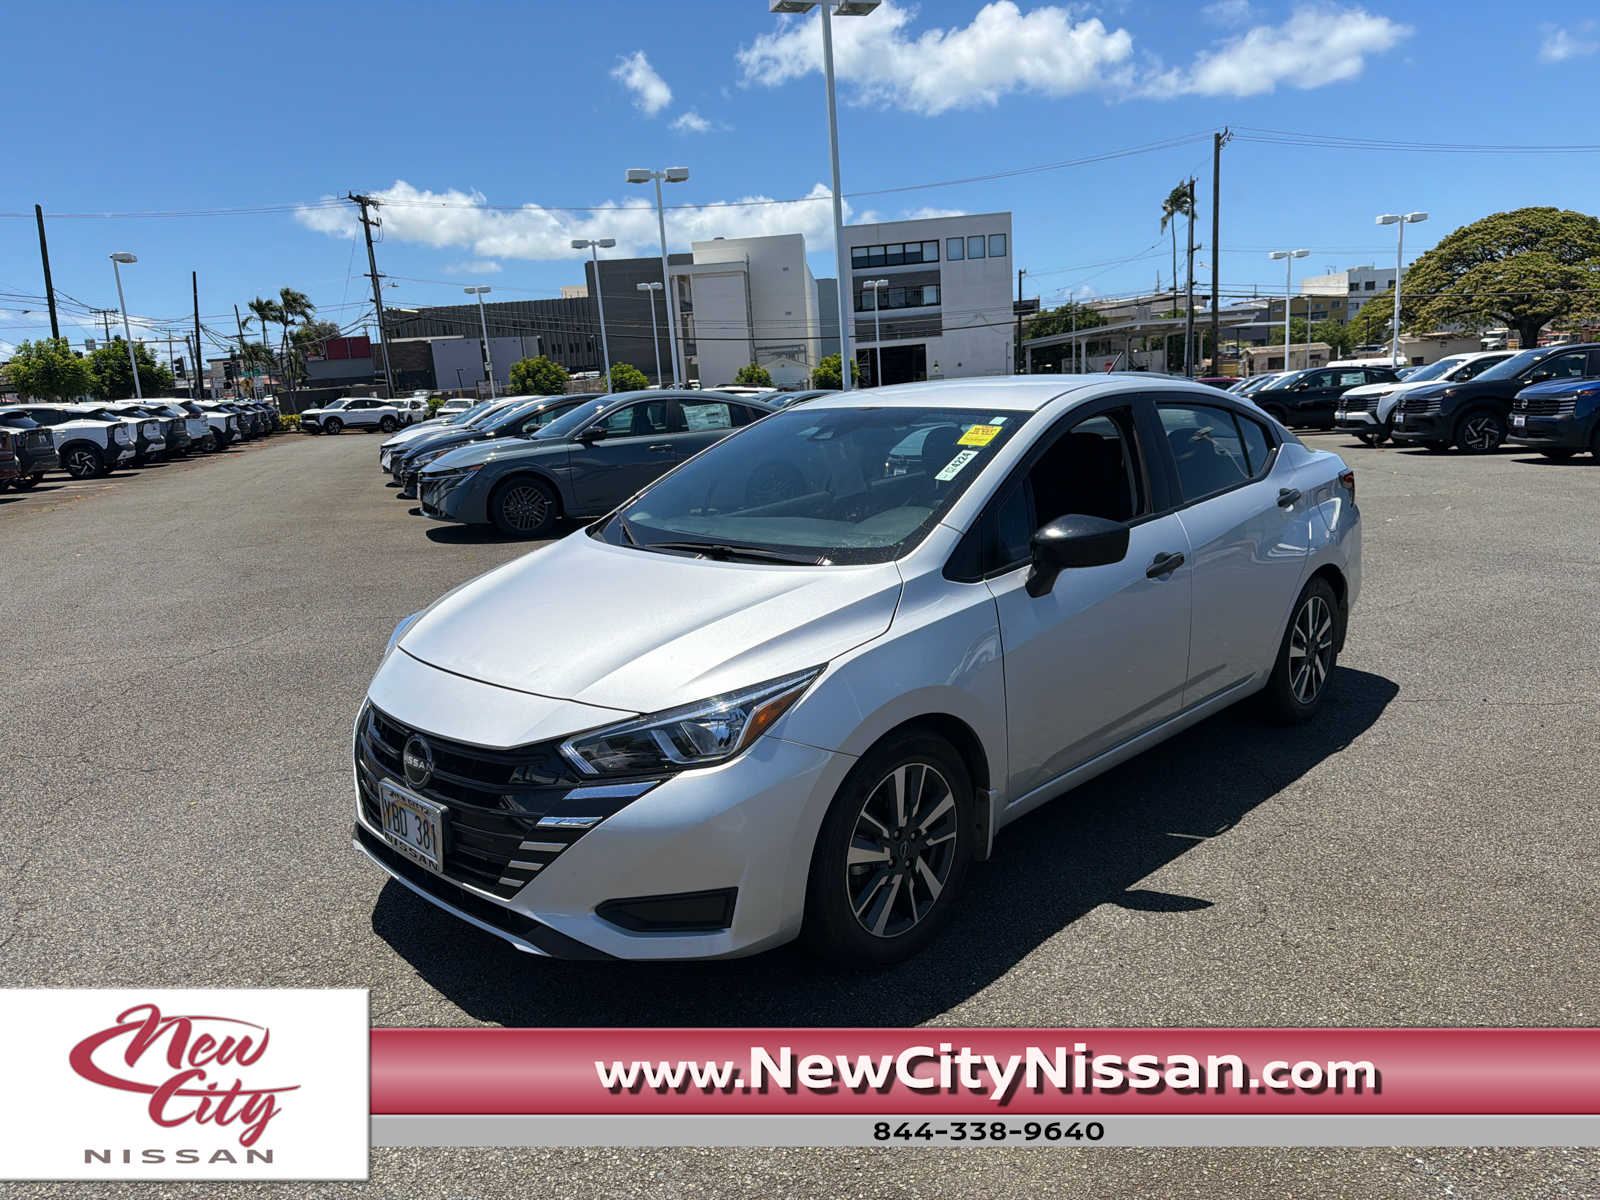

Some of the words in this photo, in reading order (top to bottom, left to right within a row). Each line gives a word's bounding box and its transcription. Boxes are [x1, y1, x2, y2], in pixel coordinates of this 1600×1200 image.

[383, 798, 408, 837] YBD
[415, 815, 437, 856] 381
[384, 831, 438, 871] NISSAN
